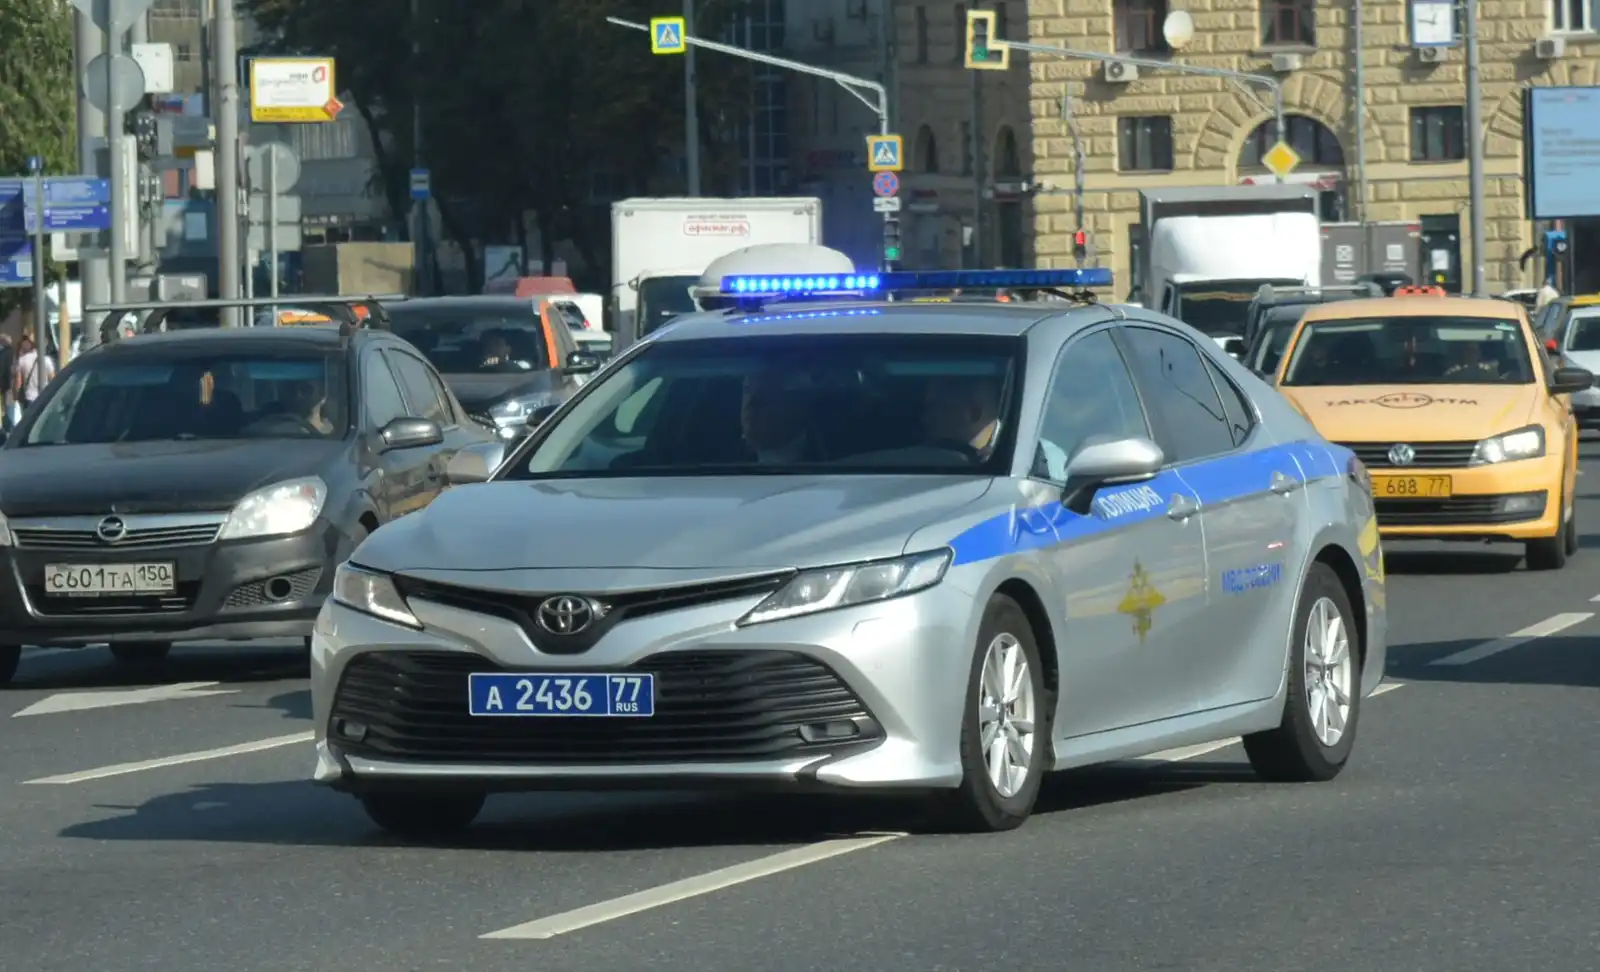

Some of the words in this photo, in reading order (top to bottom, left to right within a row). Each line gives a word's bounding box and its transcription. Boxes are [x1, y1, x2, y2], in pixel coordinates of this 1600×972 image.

[1386, 477, 1418, 494] 688
[52, 567, 133, 588] С601ТА
[137, 565, 167, 581] 150
[486, 685, 503, 710] А
[515, 678, 593, 711] 2436
[611, 677, 642, 702] 77
[615, 702, 639, 712] RUS
